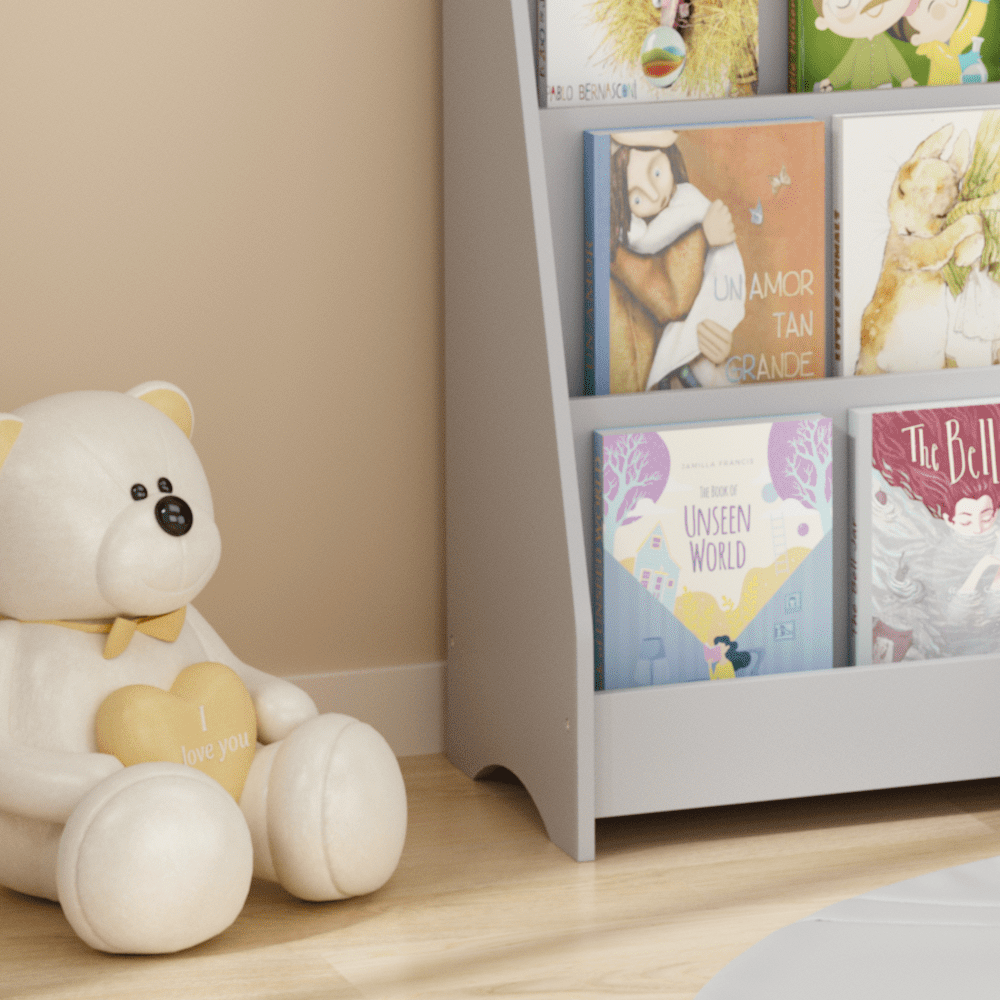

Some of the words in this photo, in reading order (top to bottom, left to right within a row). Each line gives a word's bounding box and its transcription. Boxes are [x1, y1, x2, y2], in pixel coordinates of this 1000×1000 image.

[577, 79, 638, 101] BERNASCONI
[713, 273, 743, 302] UN
[750, 269, 815, 301] AMOR
[772, 310, 814, 339] TAN
[724, 351, 815, 383] GRANDE
[901, 423, 939, 472] The
[945, 418, 999, 485] Bell
[711, 484, 729, 498] BOOK
[684, 504, 751, 538] UNSEEN
[689, 538, 747, 573] WORLD
[181, 743, 215, 766] love
[218, 731, 250, 763] you
